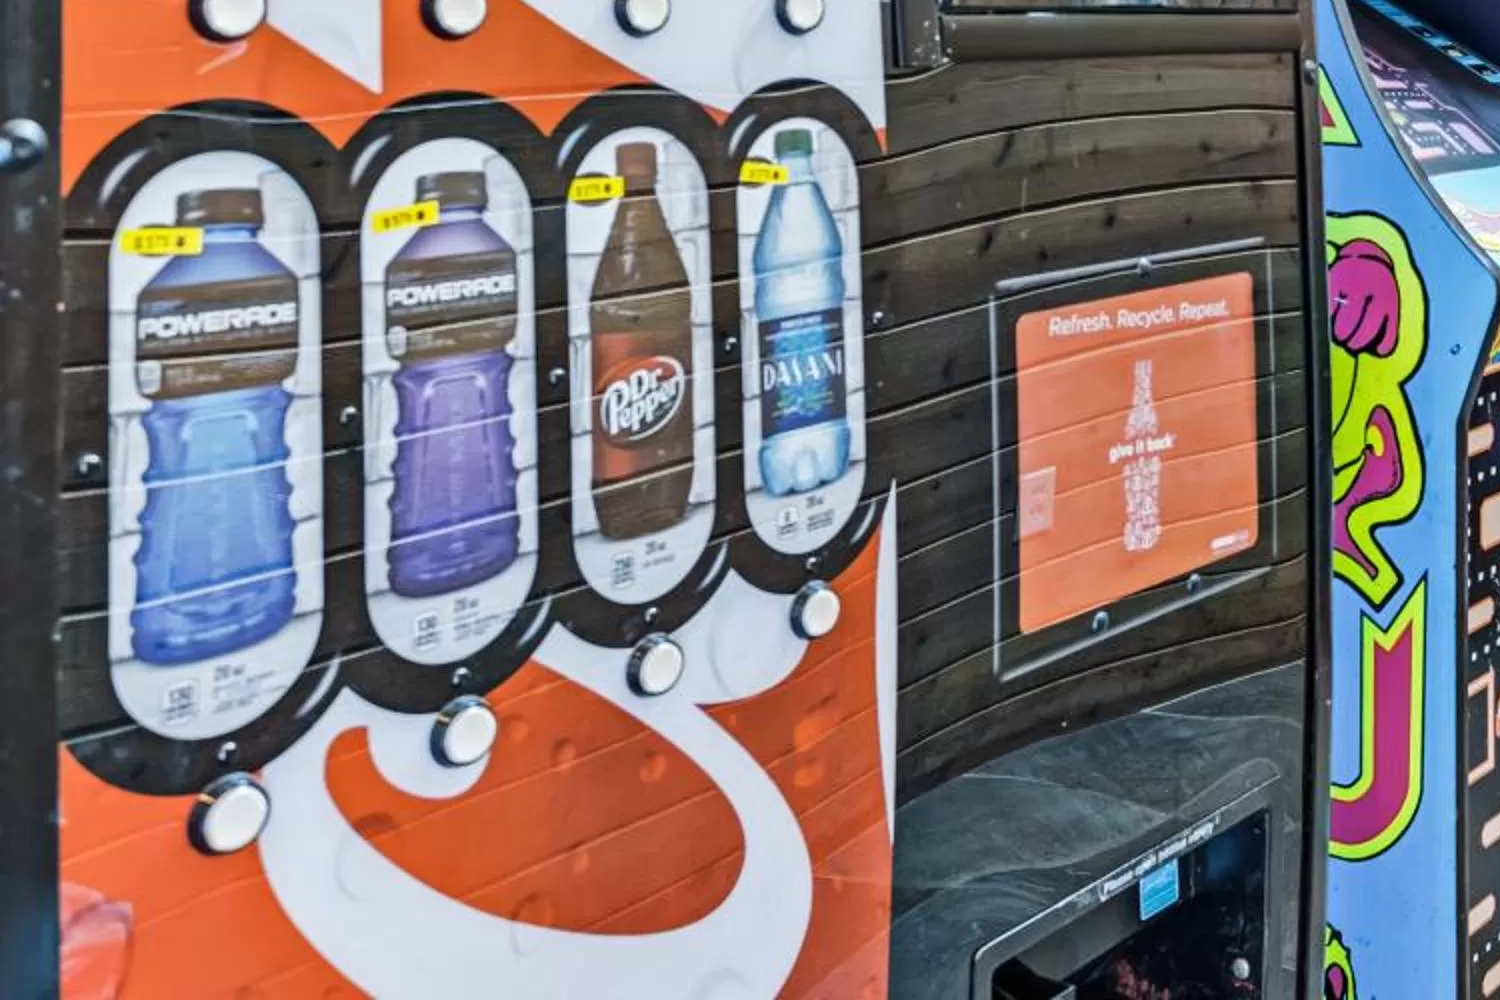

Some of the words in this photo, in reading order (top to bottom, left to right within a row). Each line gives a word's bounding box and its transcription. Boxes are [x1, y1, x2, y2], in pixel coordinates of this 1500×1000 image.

[387, 274, 515, 307] POWERADE
[138, 302, 297, 341] POWERADE
[1049, 313, 1112, 336] Refresh.
[1117, 304, 1175, 328] Recycle.
[1180, 299, 1229, 320] Repeat.
[629, 367, 662, 402] Dr
[763, 349, 843, 391] DASANI
[610, 379, 678, 436] Pepper
[1109, 442, 1133, 464] give
[1136, 438, 1145, 453] it
